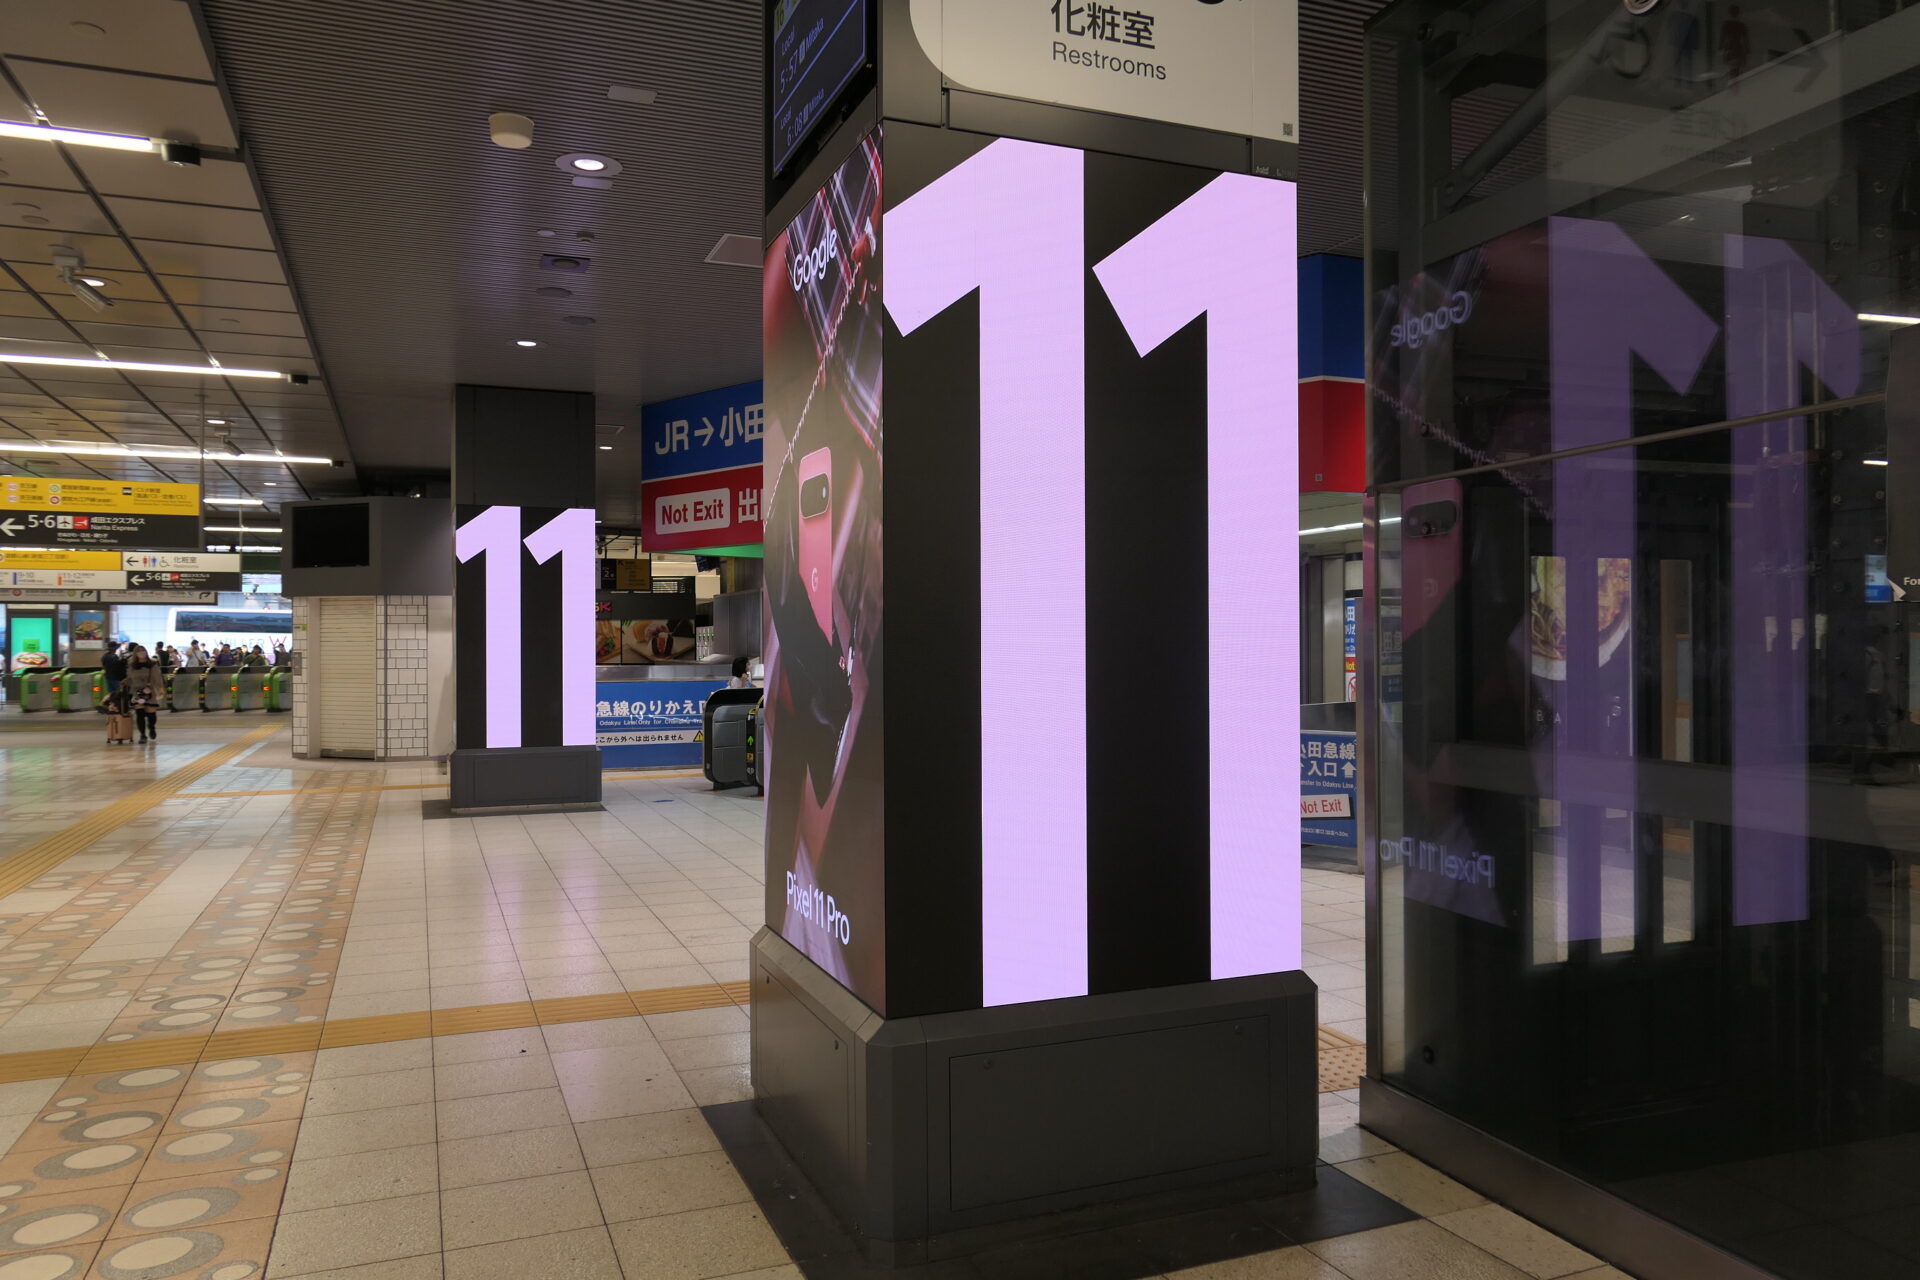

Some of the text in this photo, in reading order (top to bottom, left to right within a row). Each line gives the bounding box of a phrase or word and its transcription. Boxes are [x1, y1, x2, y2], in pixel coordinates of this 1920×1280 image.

[1051, 0, 1155, 49] 化粧室
[780, 49, 798, 94] 5:57
[1053, 41, 1167, 80] Restrooms
[793, 228, 838, 292] Google
[655, 419, 689, 455] JR
[719, 403, 764, 447] 小田
[661, 498, 724, 526] Not Exit
[882, 137, 1302, 1008] 11
[456, 505, 597, 749] 11
[1308, 760, 1338, 777] 入口
[1301, 799, 1342, 815] Not Exit
[786, 869, 850, 945] Pixel 11 Pro
